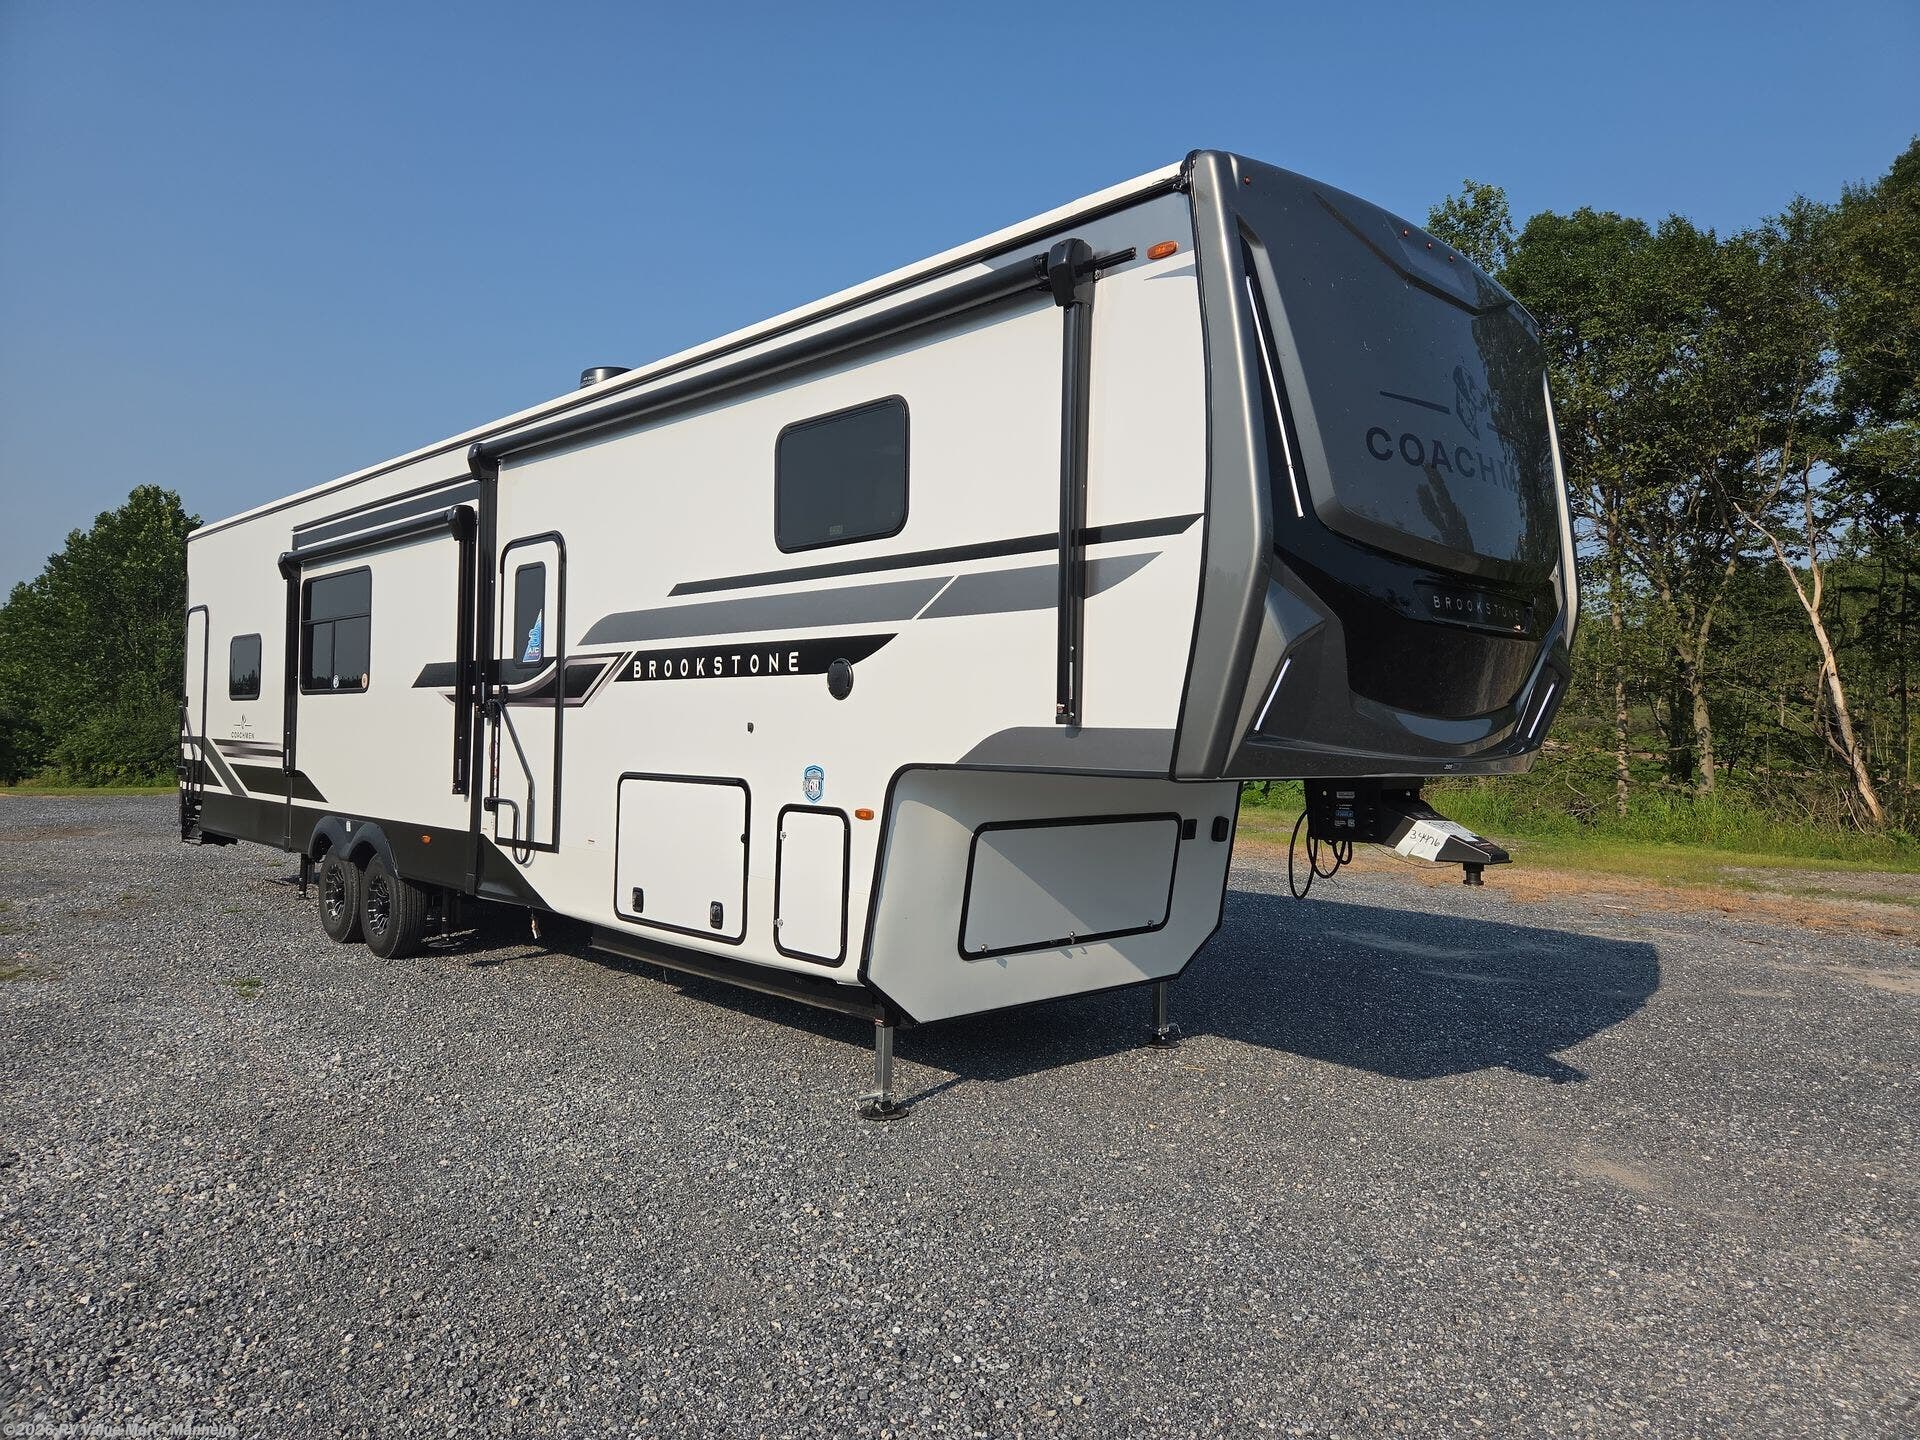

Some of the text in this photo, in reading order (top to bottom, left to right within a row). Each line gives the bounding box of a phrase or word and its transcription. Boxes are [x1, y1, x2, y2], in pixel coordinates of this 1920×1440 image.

[1366, 426, 1519, 494] COACHM
[1433, 595, 1520, 621] BROOKSTONE
[633, 651, 799, 678] BROOKSTONE
